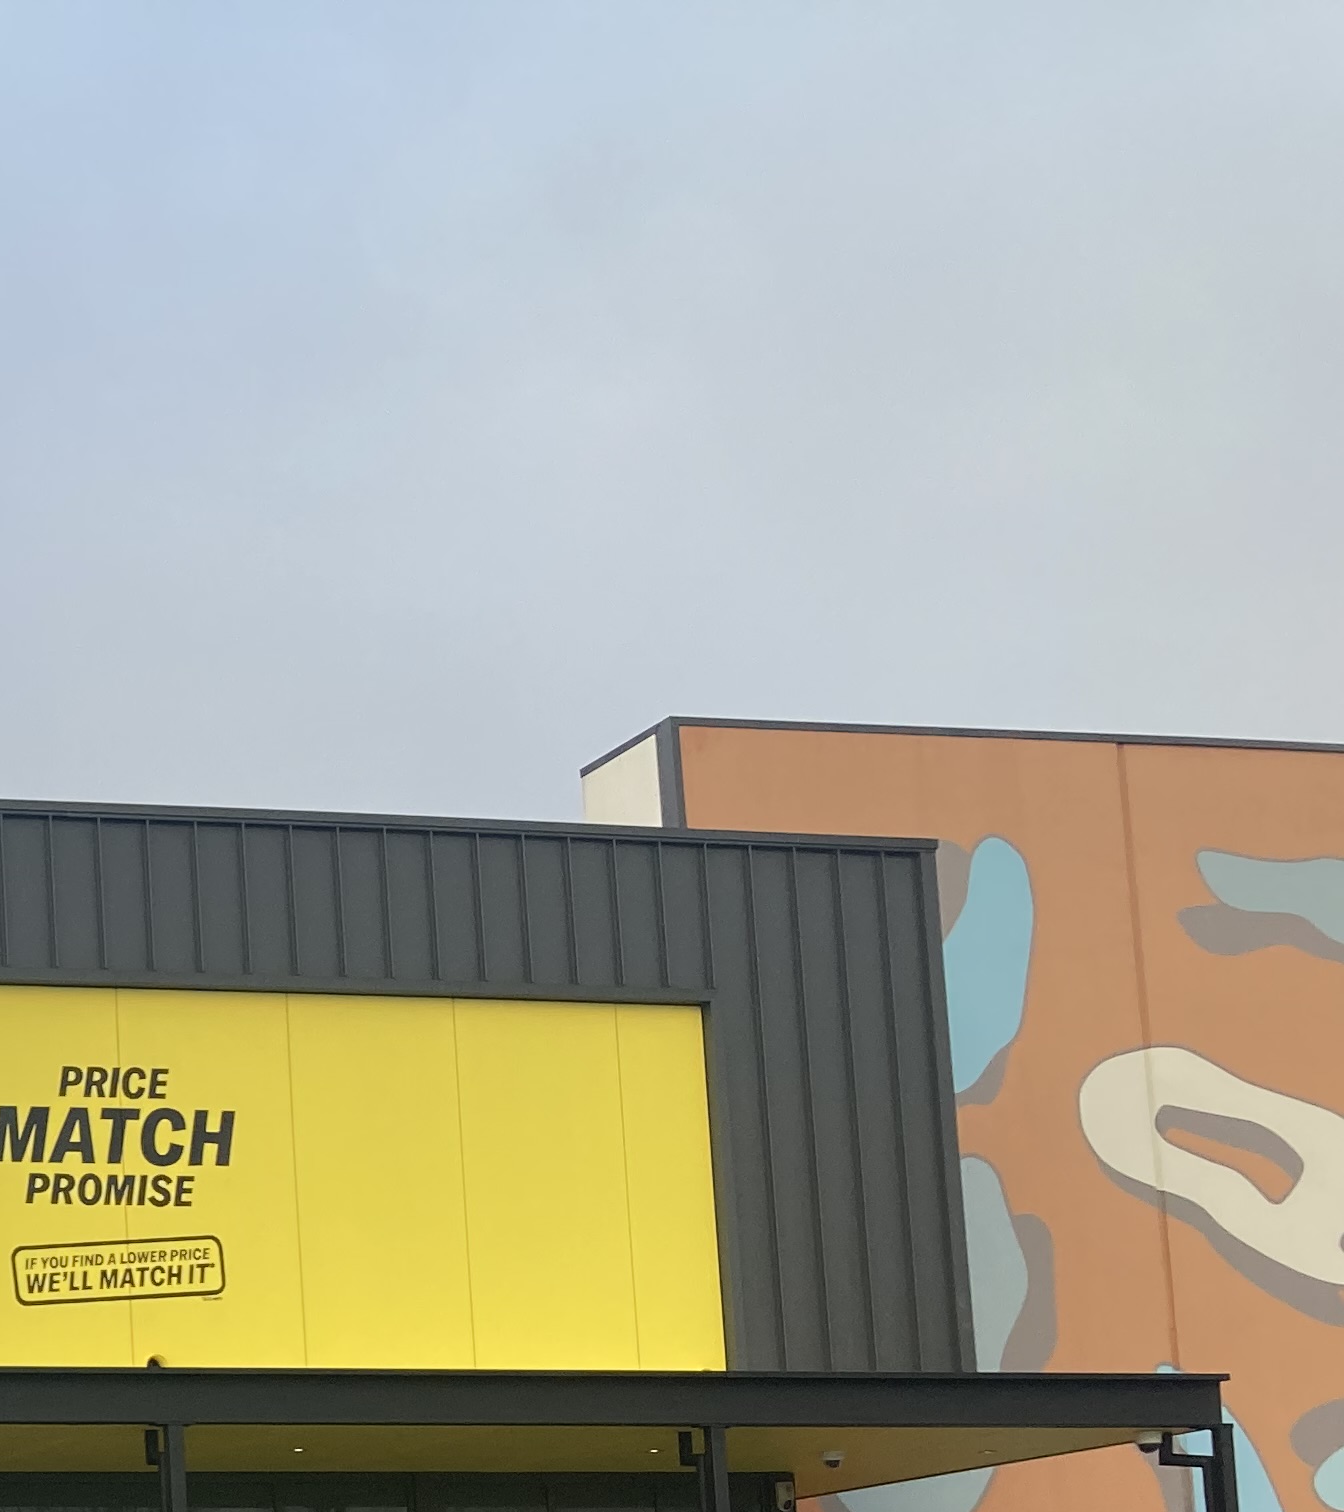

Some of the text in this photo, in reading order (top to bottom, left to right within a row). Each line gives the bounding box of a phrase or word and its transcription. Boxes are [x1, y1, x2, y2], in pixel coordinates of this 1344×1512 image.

[58, 1065, 169, 1100] PRICE
[25, 1172, 195, 1207] PROMISE
[25, 1247, 211, 1270] IF YOU FIND A LOWER PRICE
[26, 1270, 93, 1294] WE'LL
[99, 1264, 183, 1290] MATCH
